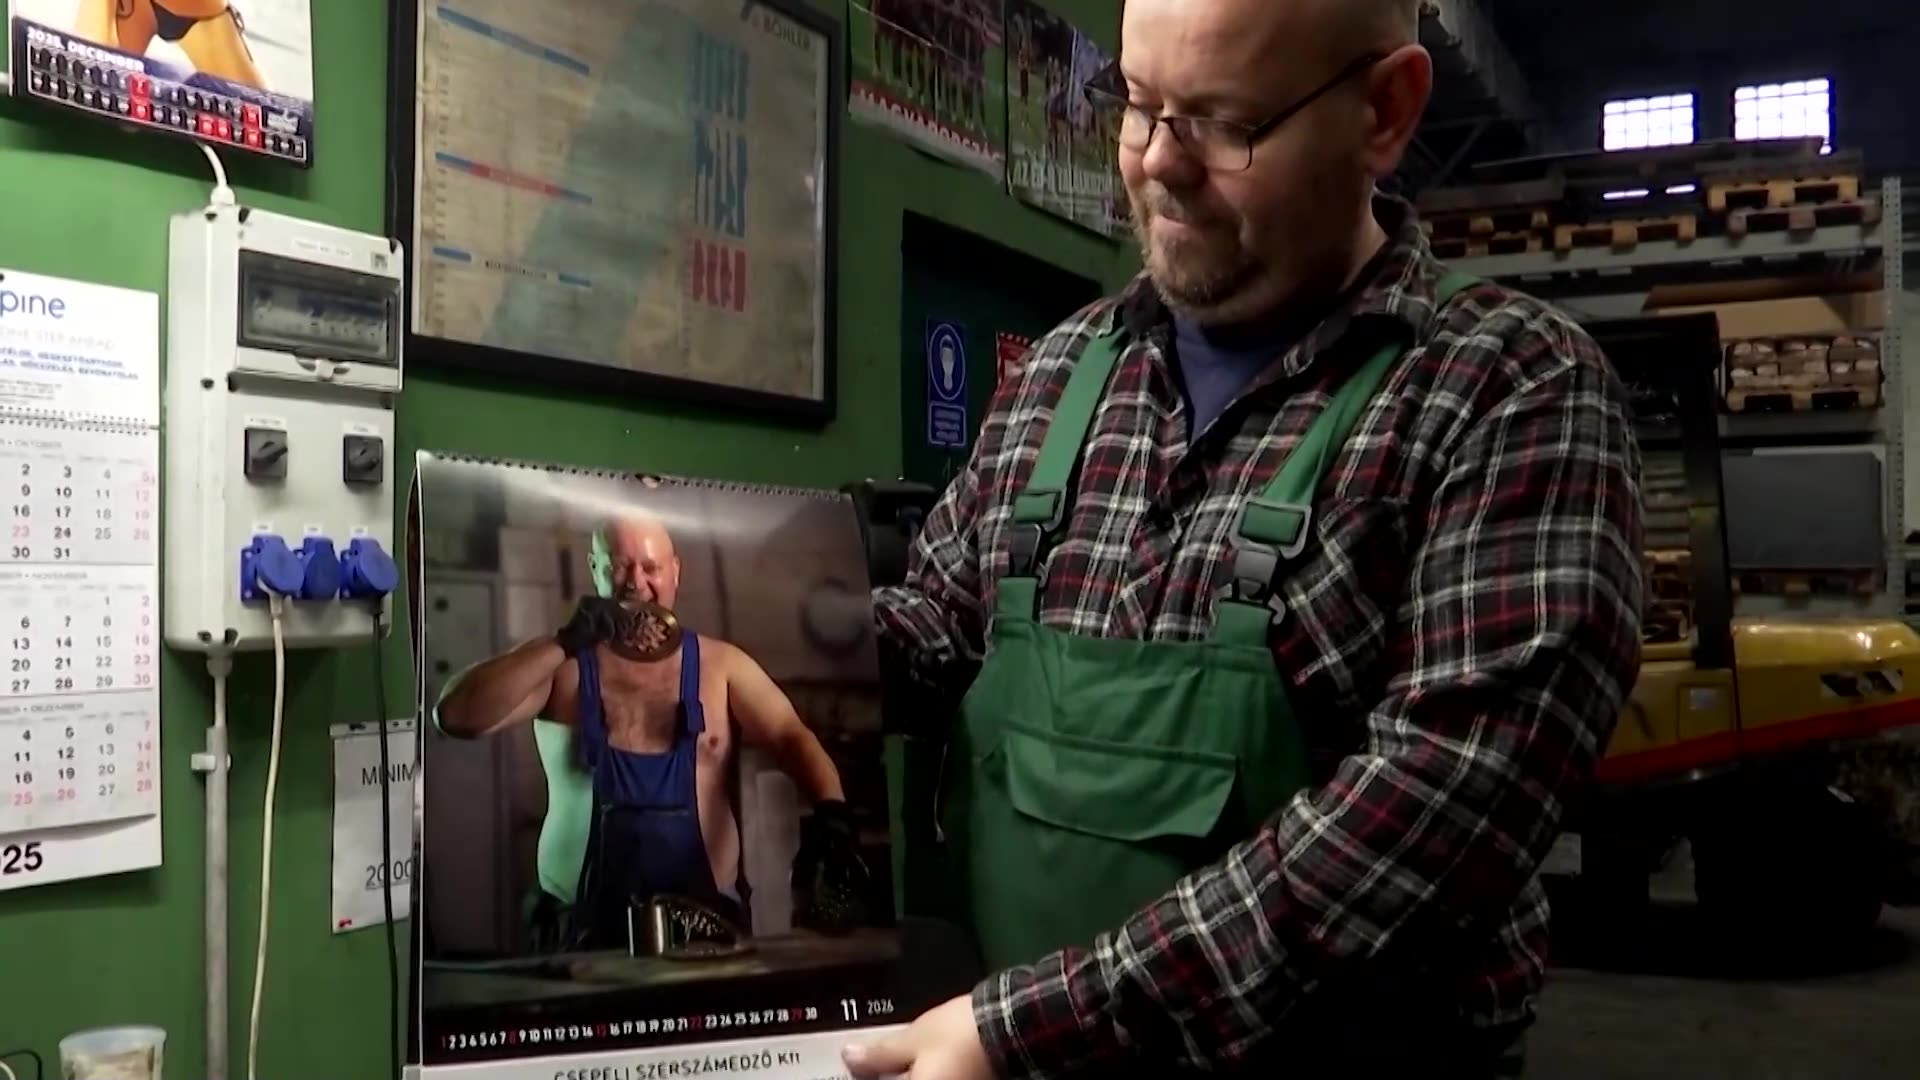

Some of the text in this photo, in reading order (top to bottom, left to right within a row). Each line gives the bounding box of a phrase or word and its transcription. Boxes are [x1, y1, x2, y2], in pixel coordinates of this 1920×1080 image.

[67, 40, 145, 72] DECEMBER
[22, 464, 30, 476] 2
[64, 464, 72, 478] 3
[104, 469, 111, 479] 4
[55, 486, 72, 498] 10
[96, 489, 110, 499] 11
[13, 505, 30, 517] 16
[55, 505, 71, 518] 17
[96, 508, 111, 520] 18
[12, 525, 30, 537] 23
[54, 527, 71, 539] 24
[95, 528, 111, 540] 25
[12, 546, 70, 559] 30 31
[105, 595, 150, 606] 1 2
[21, 616, 30, 629] 6
[64, 616, 71, 627] 7
[13, 637, 30, 650] 13
[56, 636, 72, 648] 14
[96, 636, 111, 648] 15
[12, 654, 150, 672] 20 21 22 23
[12, 674, 150, 692] 27 28 29 30
[23, 730, 31, 741] 4
[65, 726, 74, 739] 5
[106, 723, 114, 735] 6
[15, 752, 31, 762] 11
[58, 747, 74, 759] 12
[99, 744, 114, 755] 13
[15, 761, 150, 784] 18 19 20 21
[14, 793, 33, 805] 25
[58, 788, 75, 800] 26
[99, 784, 115, 796] 27
[0, 842, 43, 875] 25
[449, 1034, 456, 1049] 2
[459, 1034, 466, 1049] 3
[470, 1035, 477, 1047] 4
[480, 1032, 487, 1047] 5
[490, 1032, 497, 1046] 6
[499, 1030, 506, 1045] 7
[519, 1029, 526, 1043] 9
[529, 1028, 540, 1043] 10
[543, 1027, 552, 1041] 11
[554, 1026, 565, 1041] 12
[569, 1025, 579, 1040] 13
[582, 1024, 593, 1038] 14
[610, 1022, 620, 1037] 16
[623, 1020, 633, 1035] 17
[635, 1020, 646, 1034] 18
[649, 1019, 659, 1033] 19
[662, 1018, 675, 1033] 20
[677, 1016, 688, 1032] 21
[705, 1014, 717, 1029] 23
[720, 1013, 731, 1028] 24
[735, 1011, 747, 1026] 25
[749, 1010, 761, 1025] 26
[763, 1009, 774, 1024] 27
[776, 1008, 789, 1023] 28
[806, 1006, 818, 1021] 30
[840, 998, 858, 1021] 11
[867, 999, 895, 1016] 2026
[636, 1050, 771, 1080] SZERSZÁMEDZŐ
